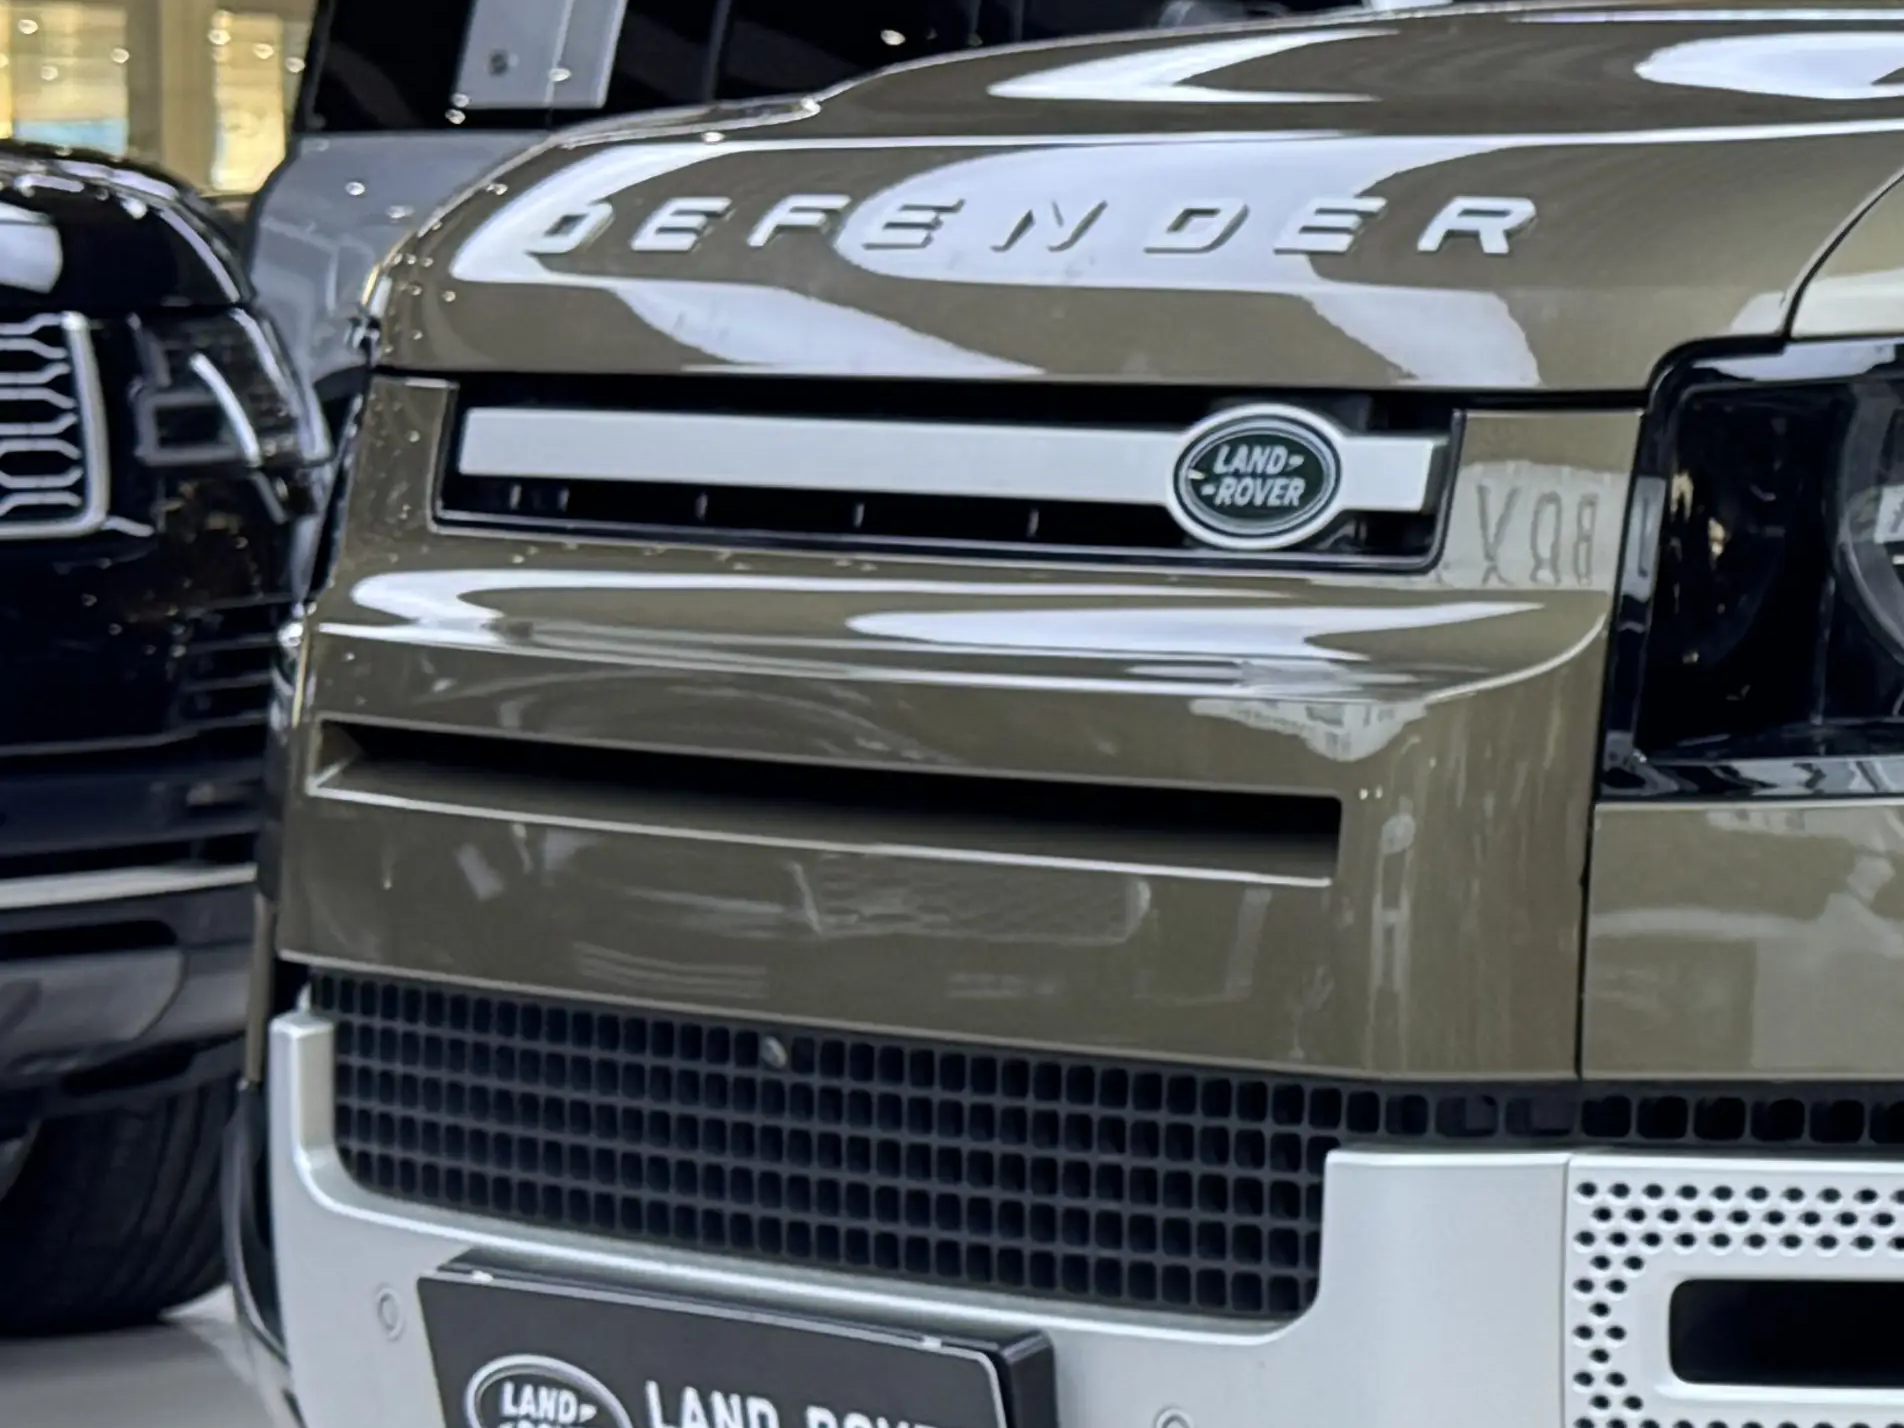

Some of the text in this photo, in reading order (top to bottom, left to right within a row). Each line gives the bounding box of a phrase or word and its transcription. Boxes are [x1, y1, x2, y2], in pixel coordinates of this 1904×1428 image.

[526, 192, 1536, 258] DEFENDER
[1212, 443, 1288, 475] LAND
[1214, 476, 1306, 507] ROVER
[502, 1379, 578, 1424] LAND
